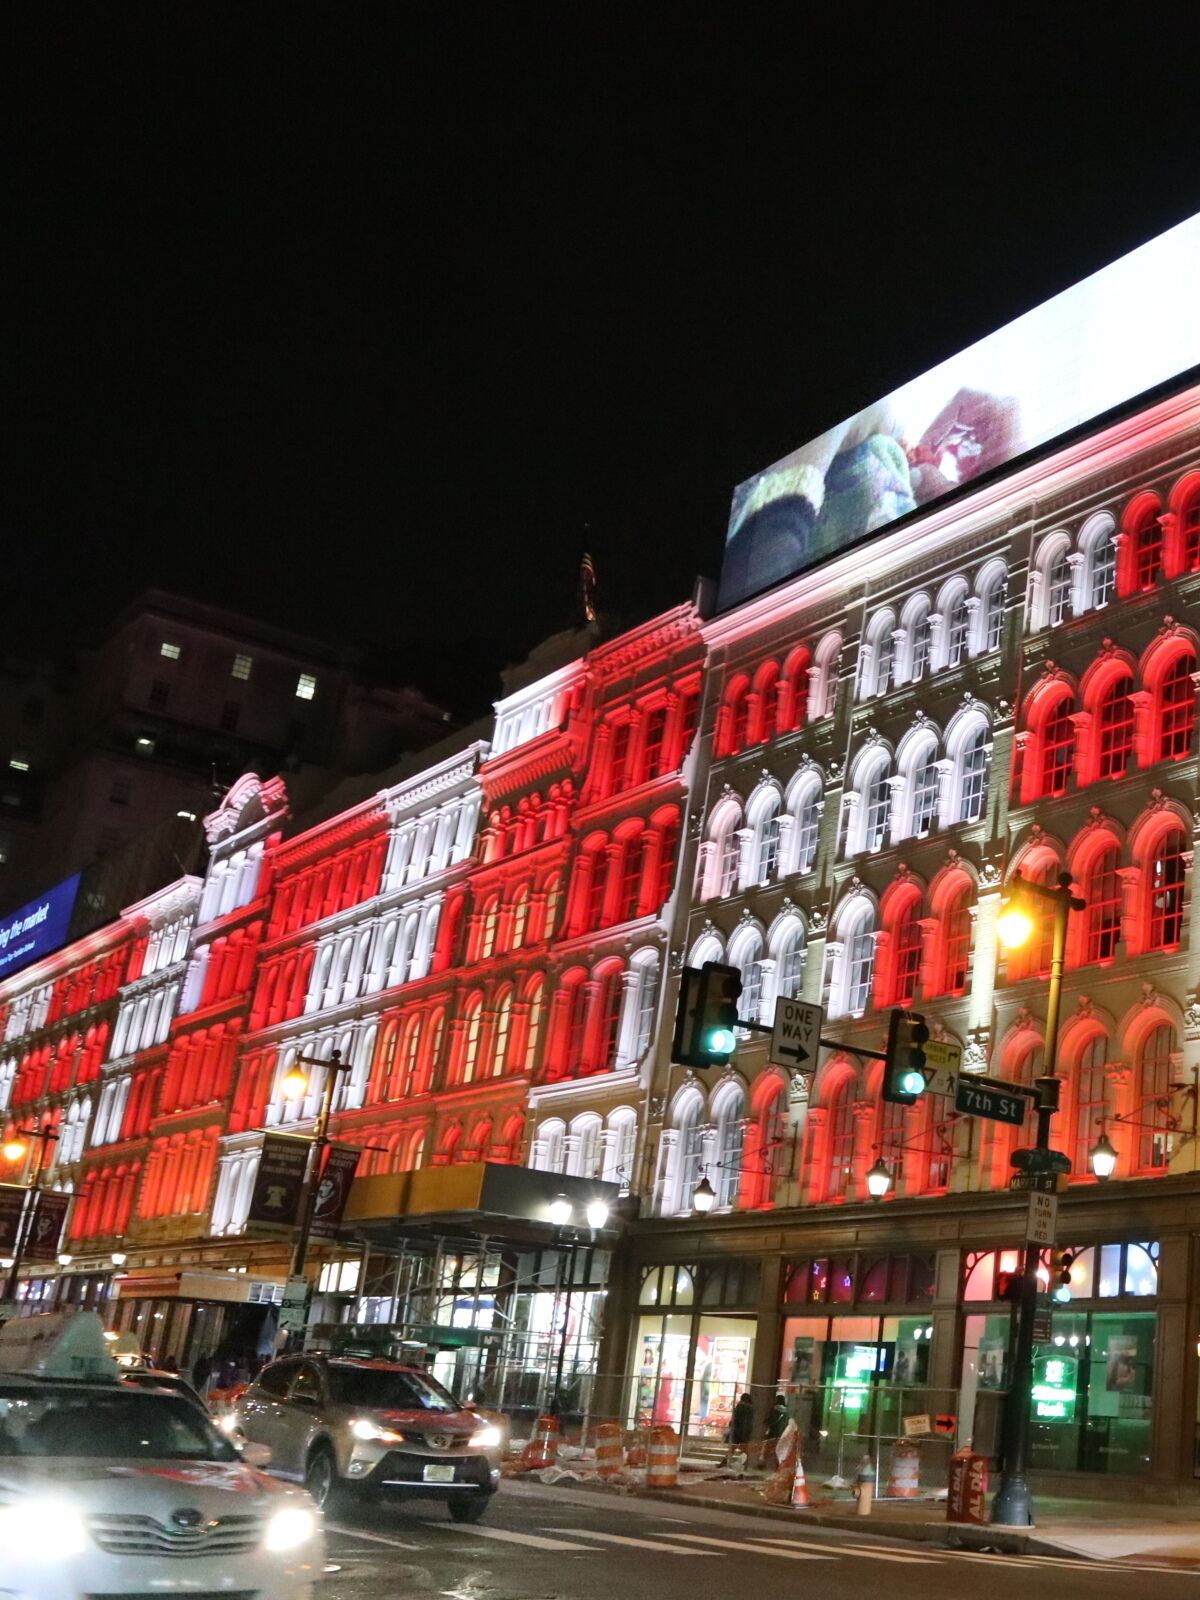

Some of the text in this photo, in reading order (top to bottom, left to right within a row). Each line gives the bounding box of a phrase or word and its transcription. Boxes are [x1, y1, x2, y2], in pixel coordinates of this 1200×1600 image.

[784, 1005, 813, 1025] ONE
[782, 1022, 813, 1042] WAY
[966, 1089, 1017, 1118] 7th St
[1045, 1180, 1053, 1190] ST
[1037, 1196, 1050, 1208] NO
[1034, 1207, 1052, 1218] TURN
[1037, 1221, 1047, 1229] ON
[1034, 1230, 1048, 1241] RED
[968, 1495, 982, 1519] AL
